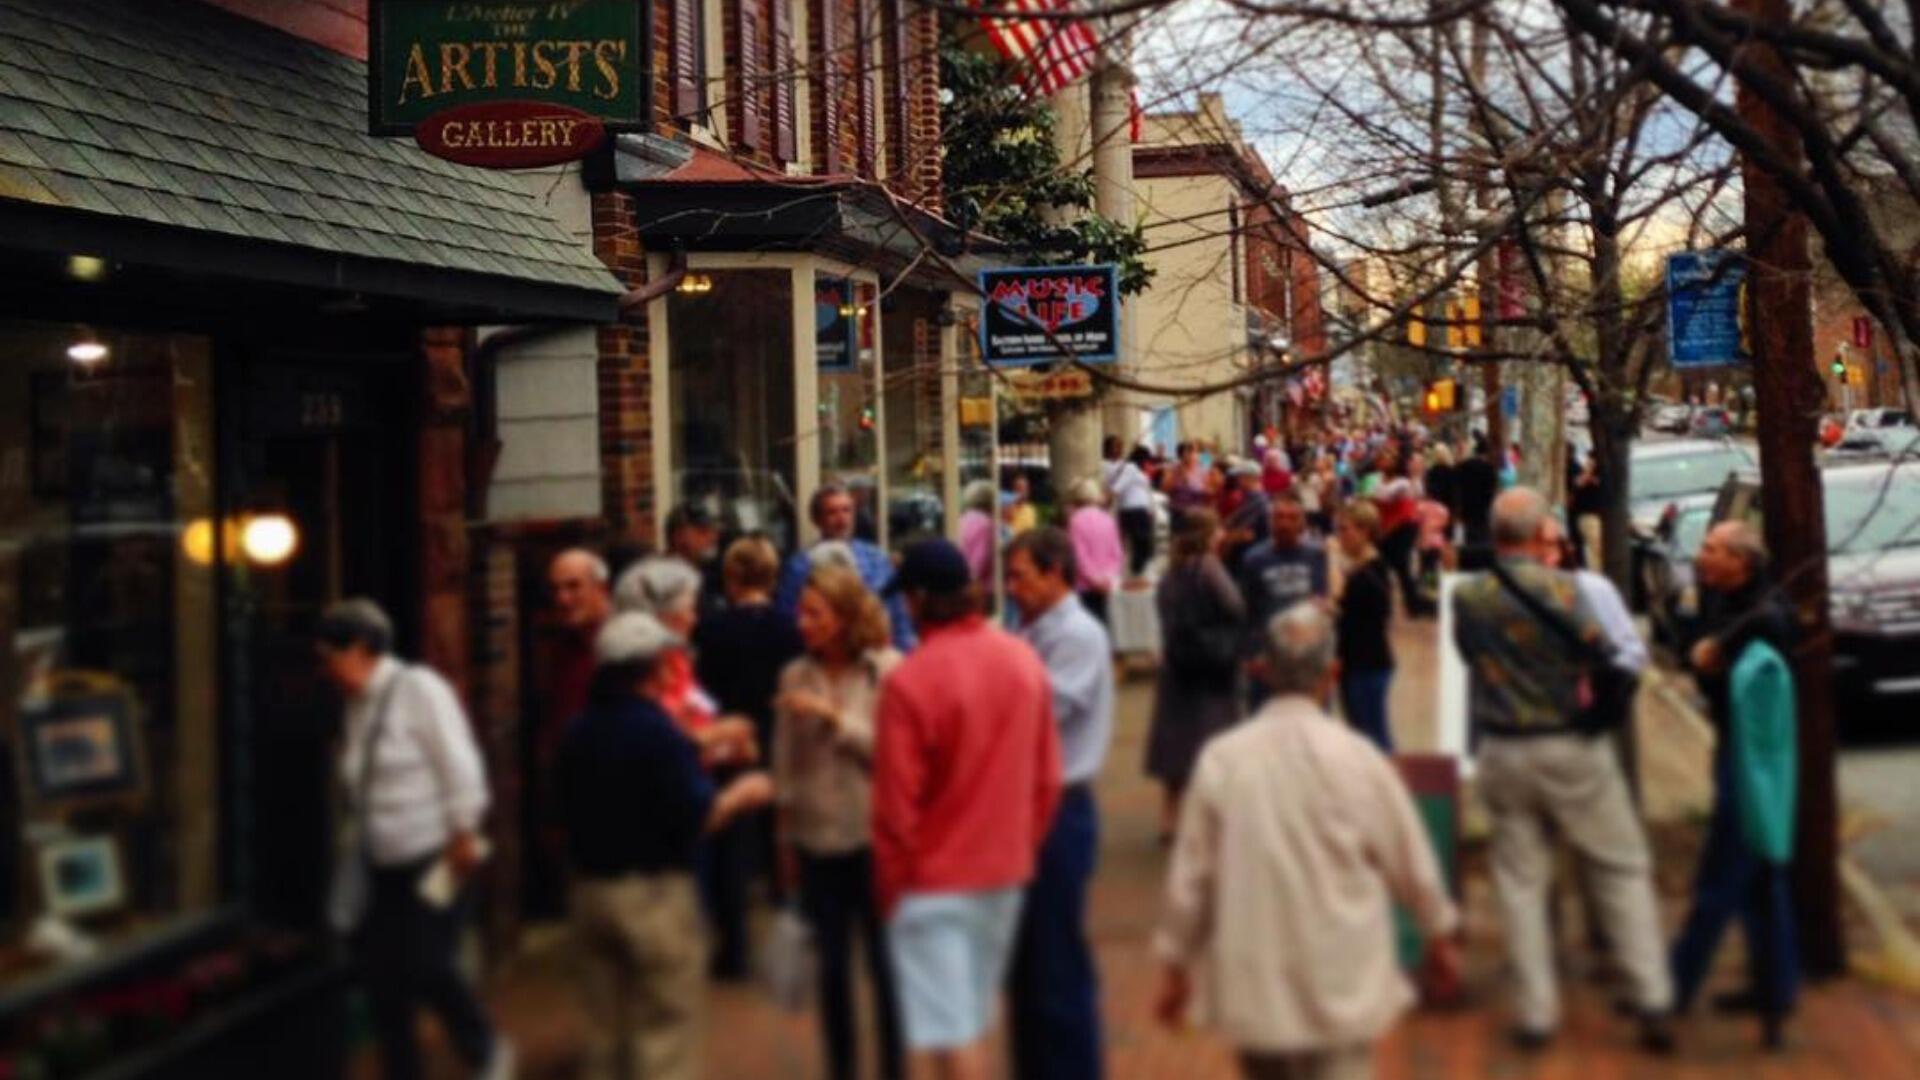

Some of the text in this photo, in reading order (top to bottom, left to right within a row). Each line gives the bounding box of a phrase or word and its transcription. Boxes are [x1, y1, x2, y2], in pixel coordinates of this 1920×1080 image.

[398, 39, 626, 105] ARTISTS'
[441, 119, 577, 148] GALLERY
[990, 276, 1104, 300] MUSIC
